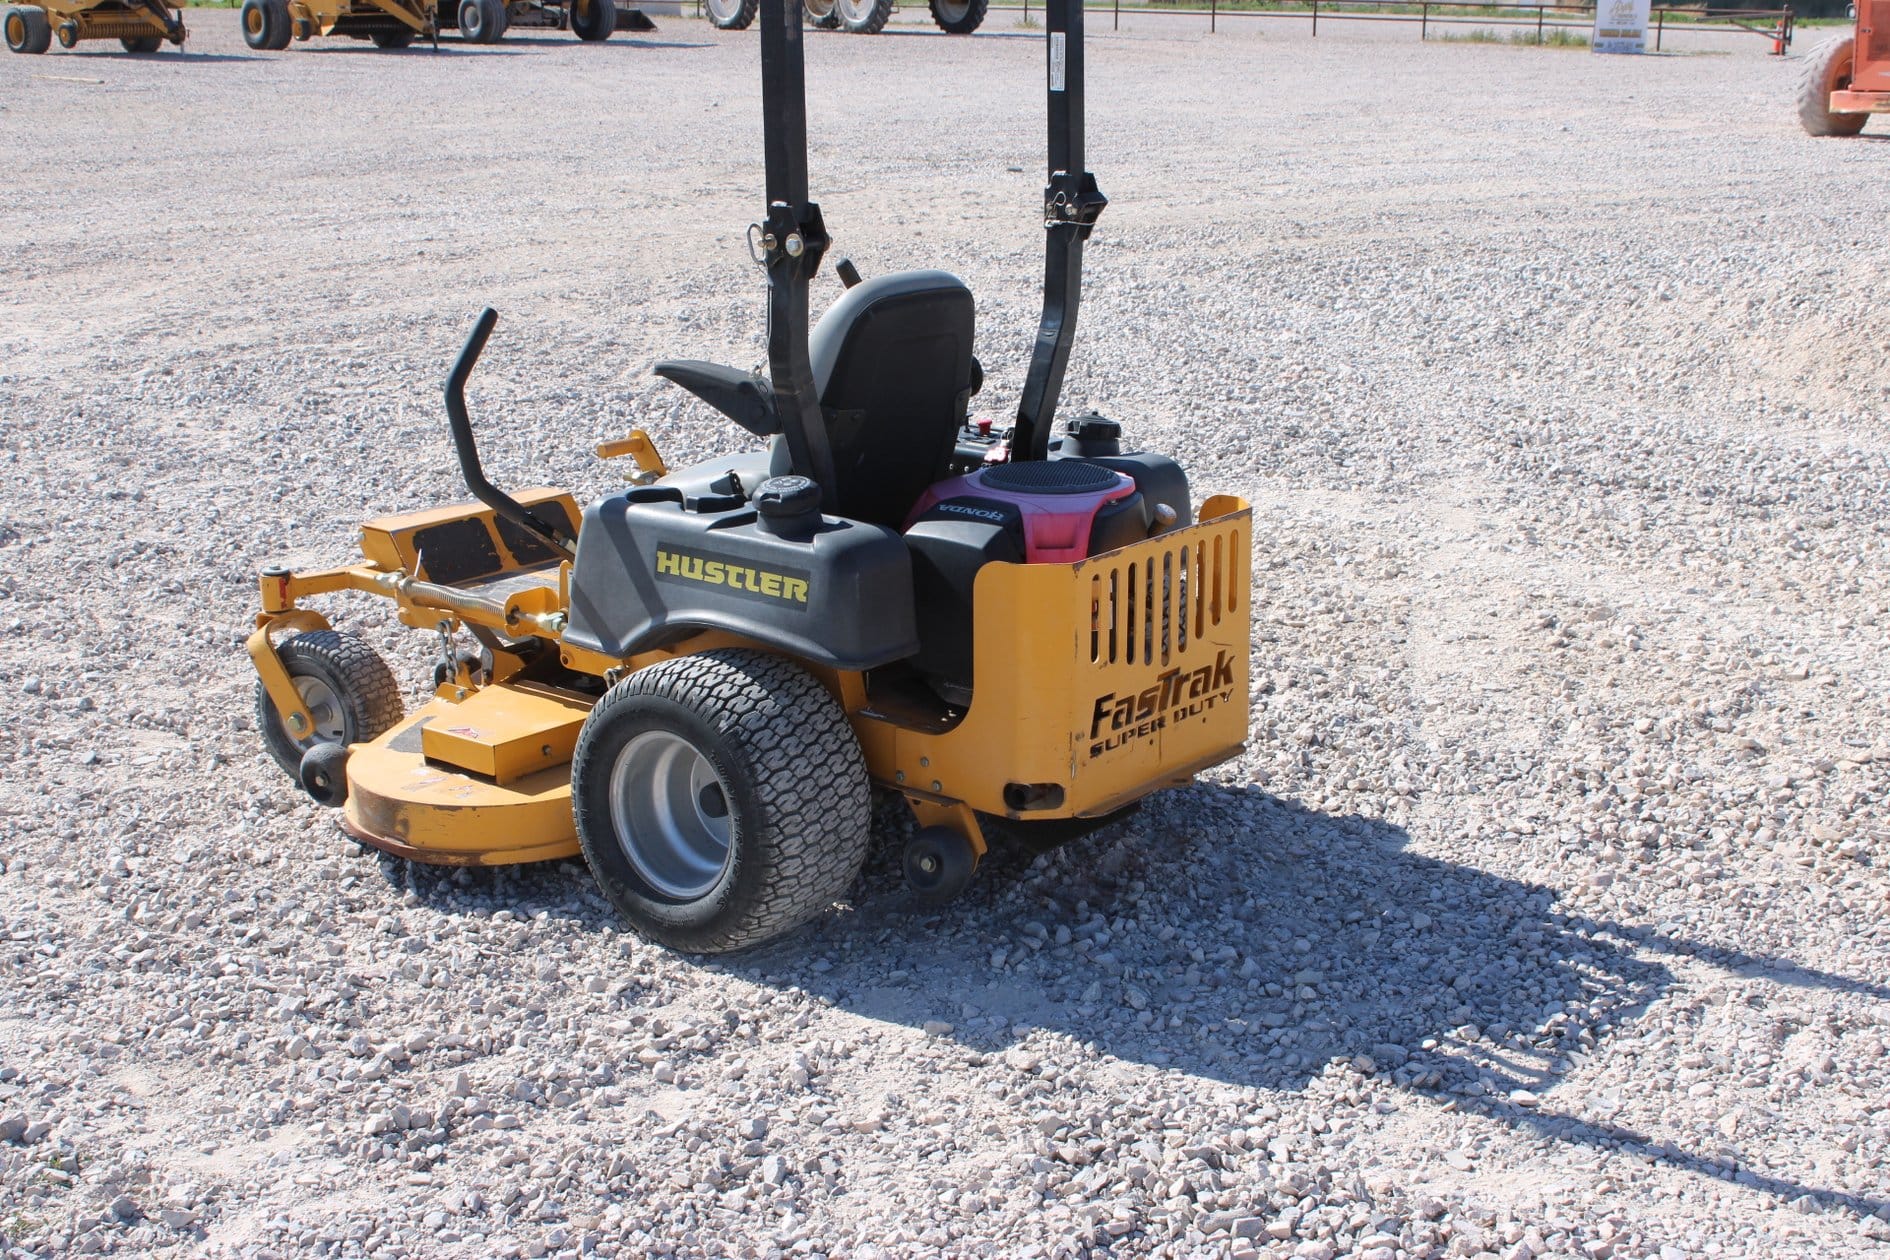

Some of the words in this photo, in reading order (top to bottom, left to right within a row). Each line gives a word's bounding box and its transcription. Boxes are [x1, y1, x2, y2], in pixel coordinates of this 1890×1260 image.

[938, 503, 1004, 521] HONDA
[656, 551, 809, 603] HUSTLER
[1090, 715, 1167, 759] SUPER
[1174, 688, 1234, 723] DUTY
